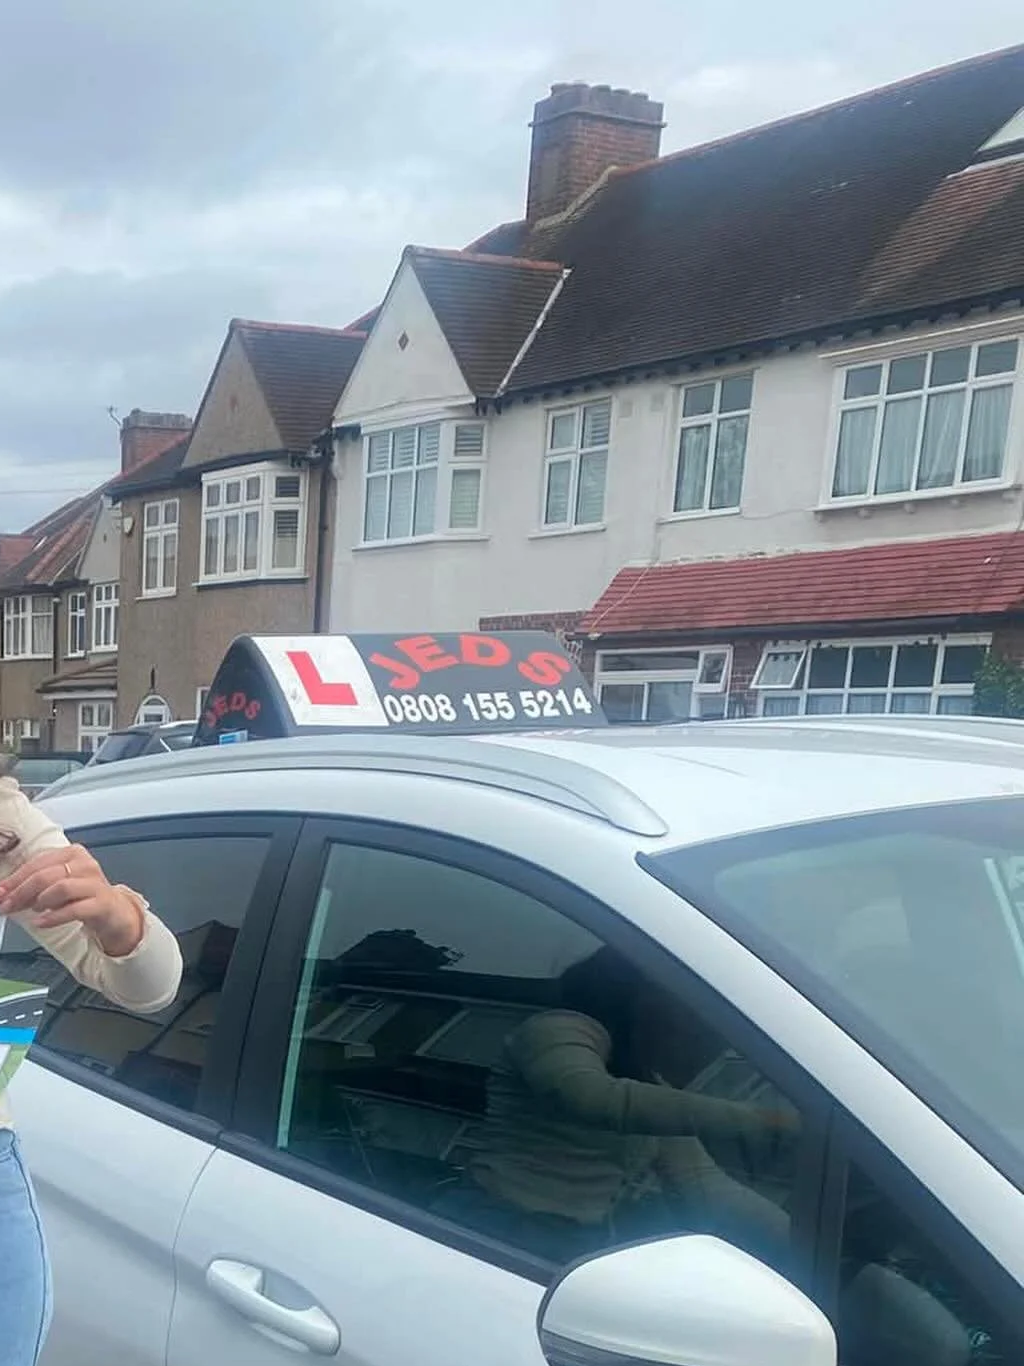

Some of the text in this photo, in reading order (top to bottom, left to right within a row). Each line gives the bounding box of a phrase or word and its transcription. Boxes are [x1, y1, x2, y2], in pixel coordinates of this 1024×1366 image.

[286, 651, 358, 706] L
[370, 633, 571, 690] JEDS
[205, 691, 261, 728] JEDS
[383, 687, 593, 724] 0808 155 5214
